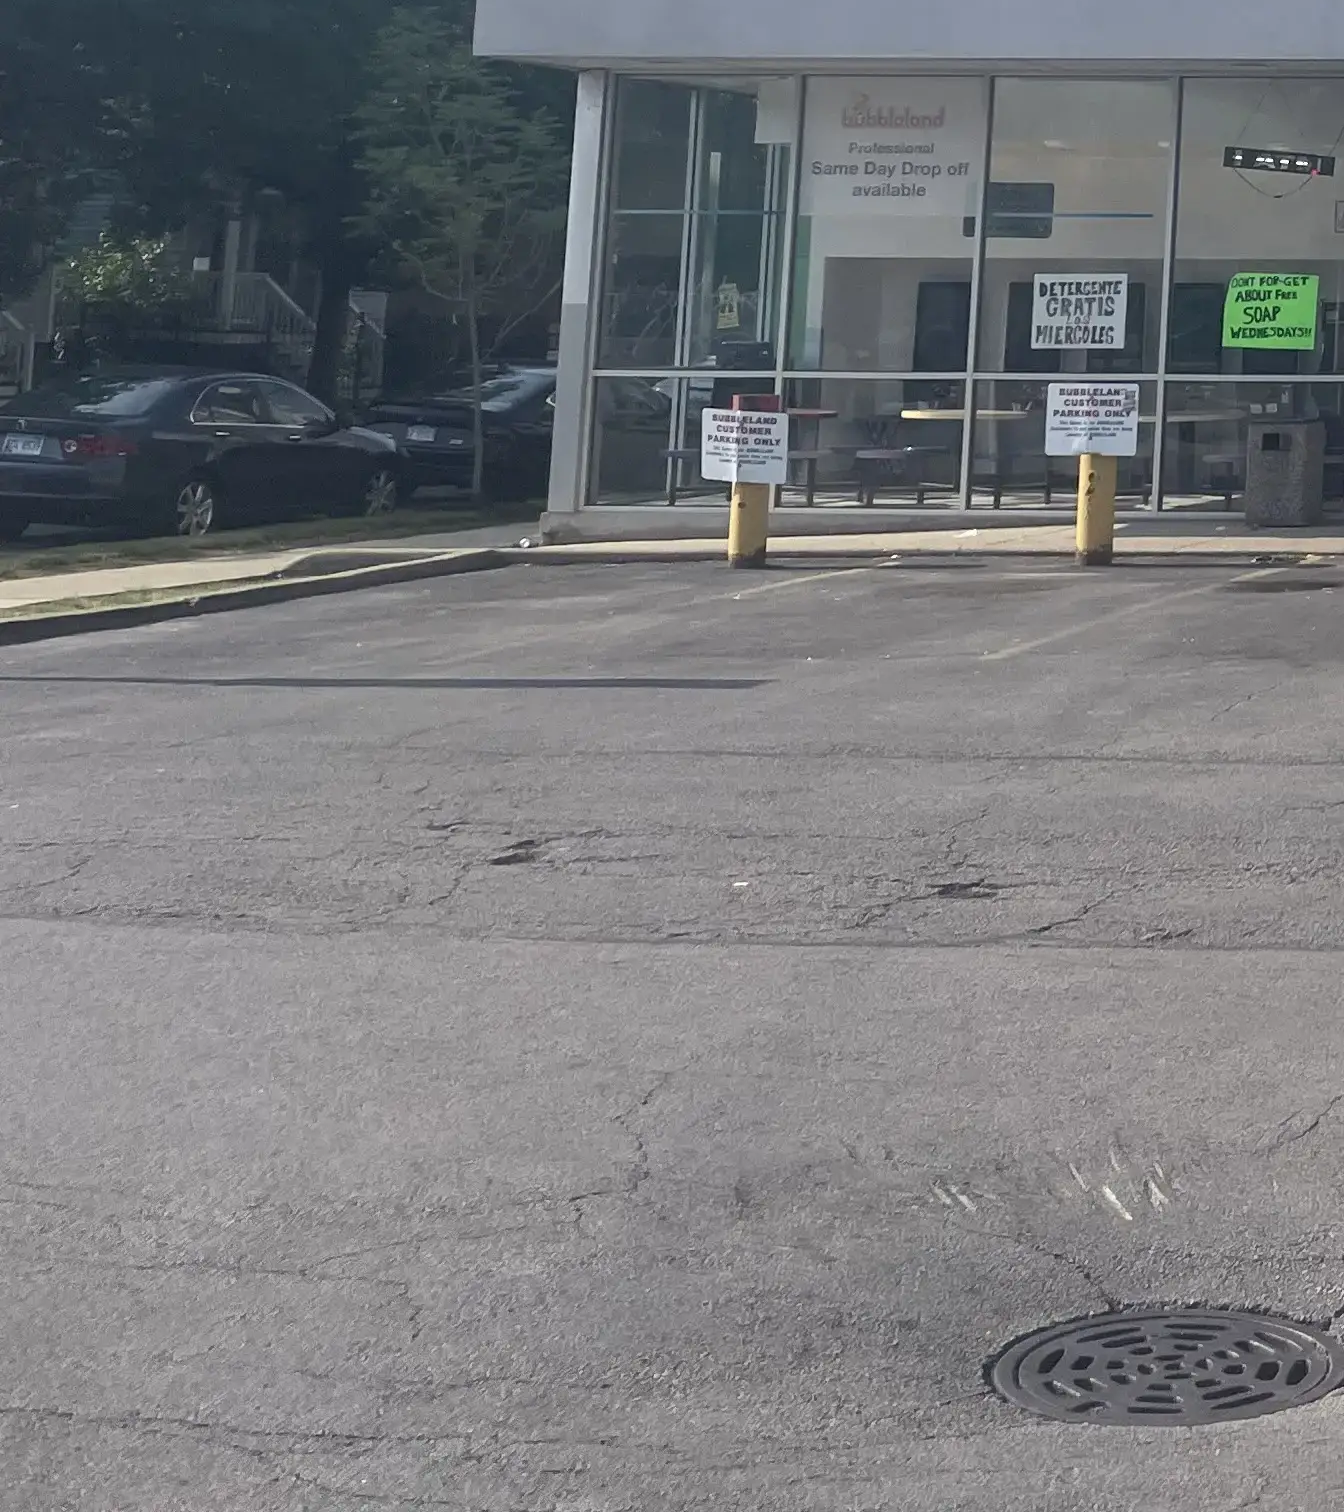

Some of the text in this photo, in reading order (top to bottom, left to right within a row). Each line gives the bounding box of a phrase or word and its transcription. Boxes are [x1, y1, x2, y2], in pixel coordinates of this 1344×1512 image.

[848, 142, 936, 154] Professional
[811, 160, 970, 178] Same Day Drop off
[852, 182, 927, 197] available
[1039, 281, 1123, 298] DETERGENTE
[1235, 289, 1273, 302] ABOUT
[1046, 296, 1116, 317] GRATIS
[1242, 305, 1281, 325] SOAP
[1035, 325, 1115, 345] MIERCOLES
[1063, 398, 1122, 407] CUSTOMER
[1053, 409, 1132, 418] PARKING ONLY
[716, 424, 772, 435] CUSTOMER
[707, 434, 782, 446] PARKING ONLY
